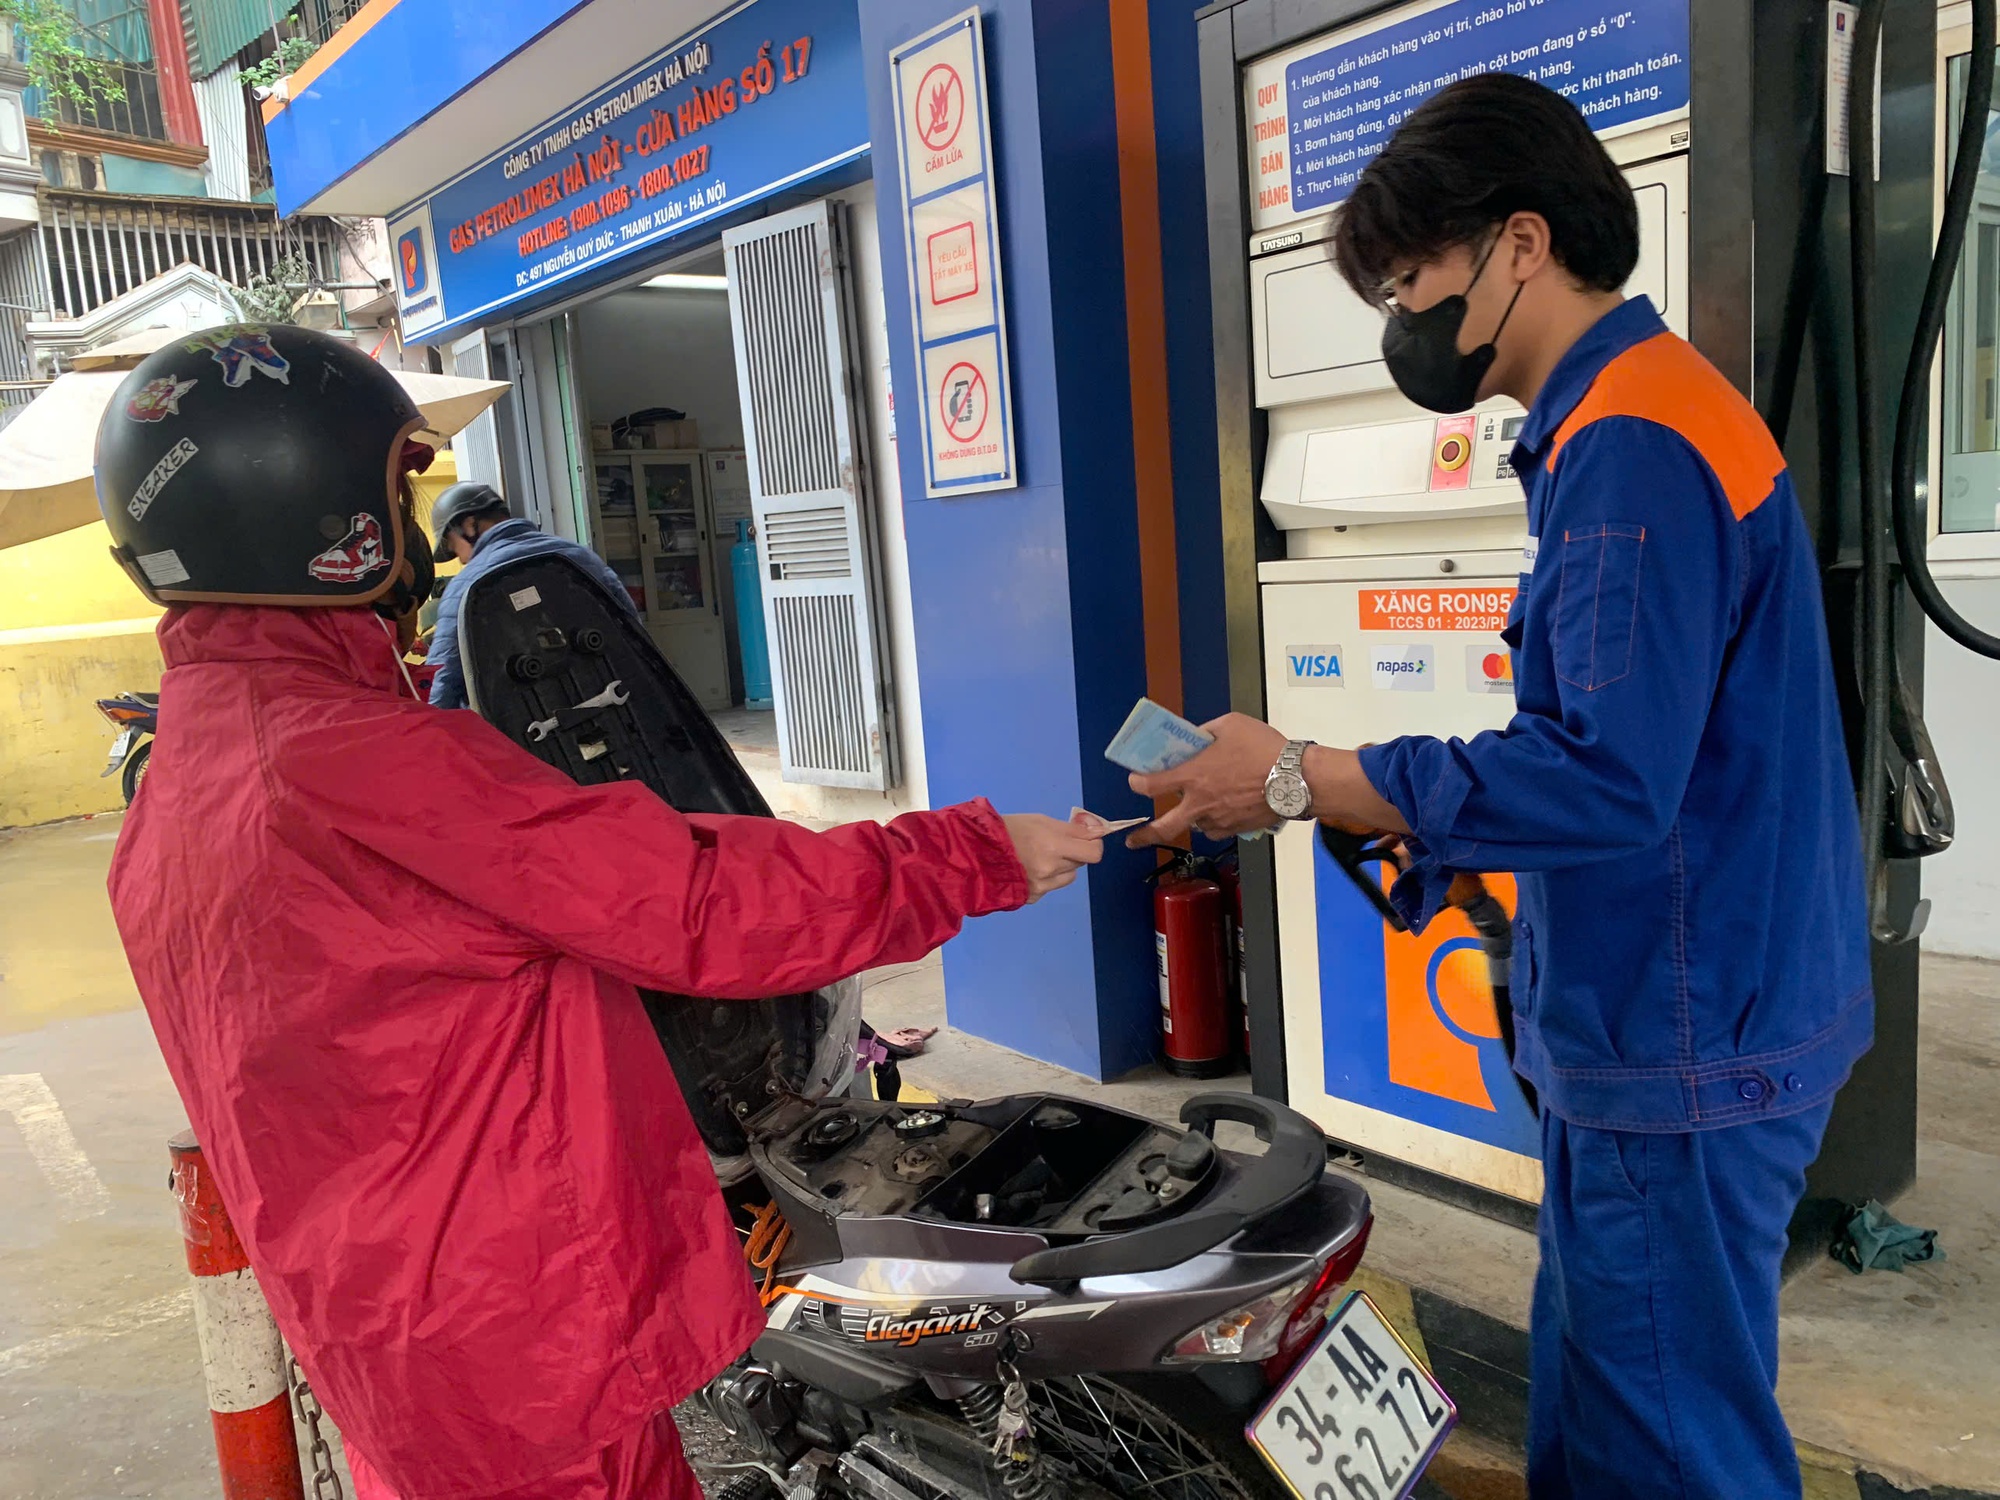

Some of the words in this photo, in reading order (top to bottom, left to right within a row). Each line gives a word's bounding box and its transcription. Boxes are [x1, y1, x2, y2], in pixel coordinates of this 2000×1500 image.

[1291, 79, 1300, 91] 1.
[1302, 68, 1335, 88] Hướng
[1337, 58, 1356, 75] dẫn
[1358, 47, 1389, 67] khách
[1391, 38, 1418, 56] hàng
[1421, 30, 1441, 45] vào
[1443, 23, 1454, 38] vị
[1456, 17, 1472, 33] trí,
[1475, 8, 1504, 26] chào
[1293, 122, 1302, 135] 2.
[1304, 114, 1322, 130] Mời
[1324, 105, 1353, 124] khách
[1356, 98, 1381, 114] hàng
[1383, 90, 1402, 105] xác
[1404, 81, 1431, 98] nhận
[1434, 72, 1458, 89] màn
[1461, 61, 1486, 79] hình
[1489, 53, 1509, 71] cột
[1511, 46, 1539, 63] bơm
[1543, 34, 1574, 53] đang
[1590, 17, 1607, 37] số
[1257, 83, 1279, 107] QUY
[1302, 95, 1320, 109] của
[1322, 83, 1351, 103] khách
[1354, 75, 1382, 91] hàng.
[503, 153, 530, 179] CÔNG
[529, 144, 544, 165] TY
[543, 126, 570, 156] TNHH
[571, 114, 594, 140] GAS
[594, 71, 664, 128] PETROLIMEX
[665, 56, 684, 87] HÀ
[685, 42, 710, 74] NỘI
[1294, 143, 1303, 155] 3.
[1305, 138, 1328, 152] Bơm
[1330, 128, 1354, 145] hàng
[1356, 118, 1386, 136] đúng,
[1387, 111, 1401, 126] đủ
[1540, 60, 1575, 79] hàng.
[1295, 165, 1304, 176] 4.
[1306, 157, 1324, 173] Mời
[1326, 149, 1355, 167] khách
[1357, 142, 1383, 158] hàng
[1582, 74, 1602, 91] khi
[1605, 62, 1643, 84] thanh
[1647, 52, 1682, 72] toán.
[1254, 116, 1286, 142] TRÌNH
[1296, 185, 1305, 197] 5.
[1307, 180, 1332, 194] Thực
[1334, 173, 1355, 187] hiện
[1581, 95, 1621, 117] khách
[1625, 85, 1662, 105] hàng.
[449, 219, 475, 254] GAS
[475, 172, 563, 240] PETROLIMEX
[563, 152, 588, 195] HÀ
[587, 135, 623, 183] NỘI
[624, 144, 635, 154] -
[636, 109, 677, 157] CỬA
[677, 78, 737, 136] HÀNG
[741, 40, 776, 104] SỐ
[781, 36, 811, 83] 17
[925, 153, 944, 173] CẤM
[945, 147, 964, 165] LỬA
[1260, 150, 1284, 175] BÁN
[518, 216, 570, 257] HOTLINE:
[570, 184, 631, 231] 1900.1096
[638, 144, 710, 200] 1800.1027
[1259, 184, 1289, 210] HÀNG
[529, 264, 542, 281] 497
[543, 245, 576, 275] NGUYỄN
[576, 237, 594, 261] QUÝ
[595, 230, 614, 253] ĐỨC
[620, 214, 652, 241] THANH
[654, 201, 683, 228] XUÂN
[688, 188, 705, 212] HÀ
[706, 179, 727, 206] NỘI
[1262, 233, 1301, 252] TATSUNO
[937, 250, 951, 264] YÊU
[964, 261, 974, 272] XE
[938, 449, 959, 461] KHÔNG
[131, 440, 196, 518] SNEAKER
[1373, 590, 1432, 614] XĂNG
[1438, 593, 1511, 613] RON95
[1388, 616, 1424, 629] TCCS
[1428, 616, 1442, 629] 01
[1287, 655, 1341, 677] VISA
[1376, 660, 1415, 676] napas
[865, 1304, 993, 1346] Elegant
[964, 1332, 999, 1348] 50
[1277, 1323, 1388, 1466] 34-AA
